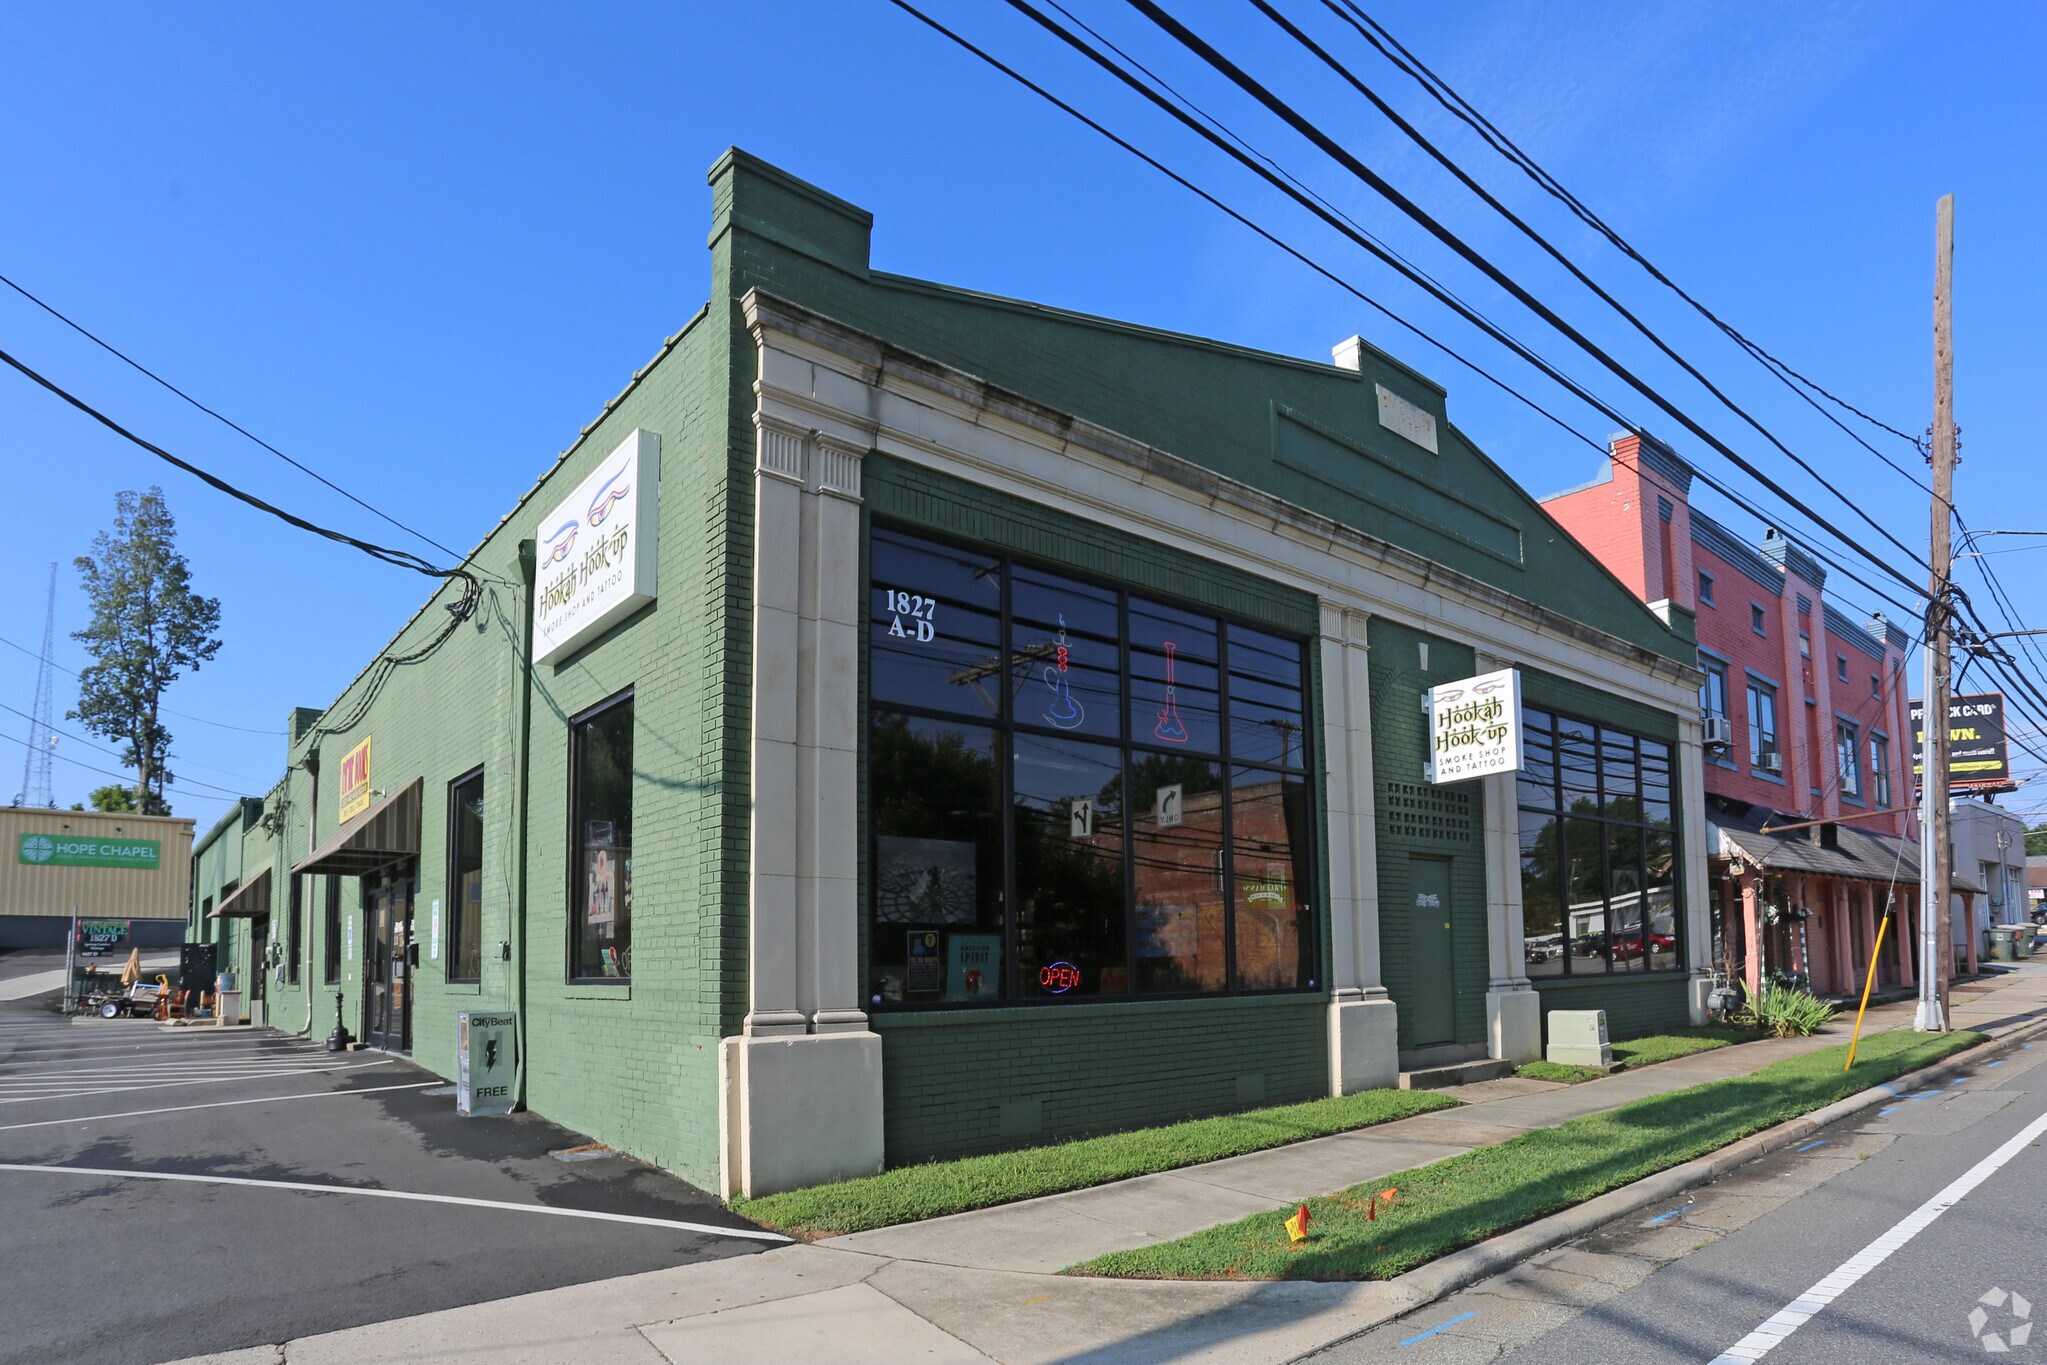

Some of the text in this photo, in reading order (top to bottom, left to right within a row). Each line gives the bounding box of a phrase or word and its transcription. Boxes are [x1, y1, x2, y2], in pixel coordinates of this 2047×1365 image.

[539, 563, 578, 620] Hookah
[543, 569, 623, 638] SMOKE SHOP AND TATTOO
[887, 589, 935, 620] 1827
[888, 614, 935, 643] A-D
[1438, 696, 1504, 730] Hookah
[1440, 746, 1506, 766] SMOKE SHOP
[1441, 757, 1505, 775] AND TATTOO
[56, 843, 97, 855] HOPE
[100, 845, 157, 858] CHAPEL
[82, 924, 128, 935] VINTAGE
[90, 934, 118, 942] 1827 D
[960, 952, 990, 963] SPIRIT
[1040, 966, 1080, 987] OPEN
[476, 1086, 508, 1098] FREE
